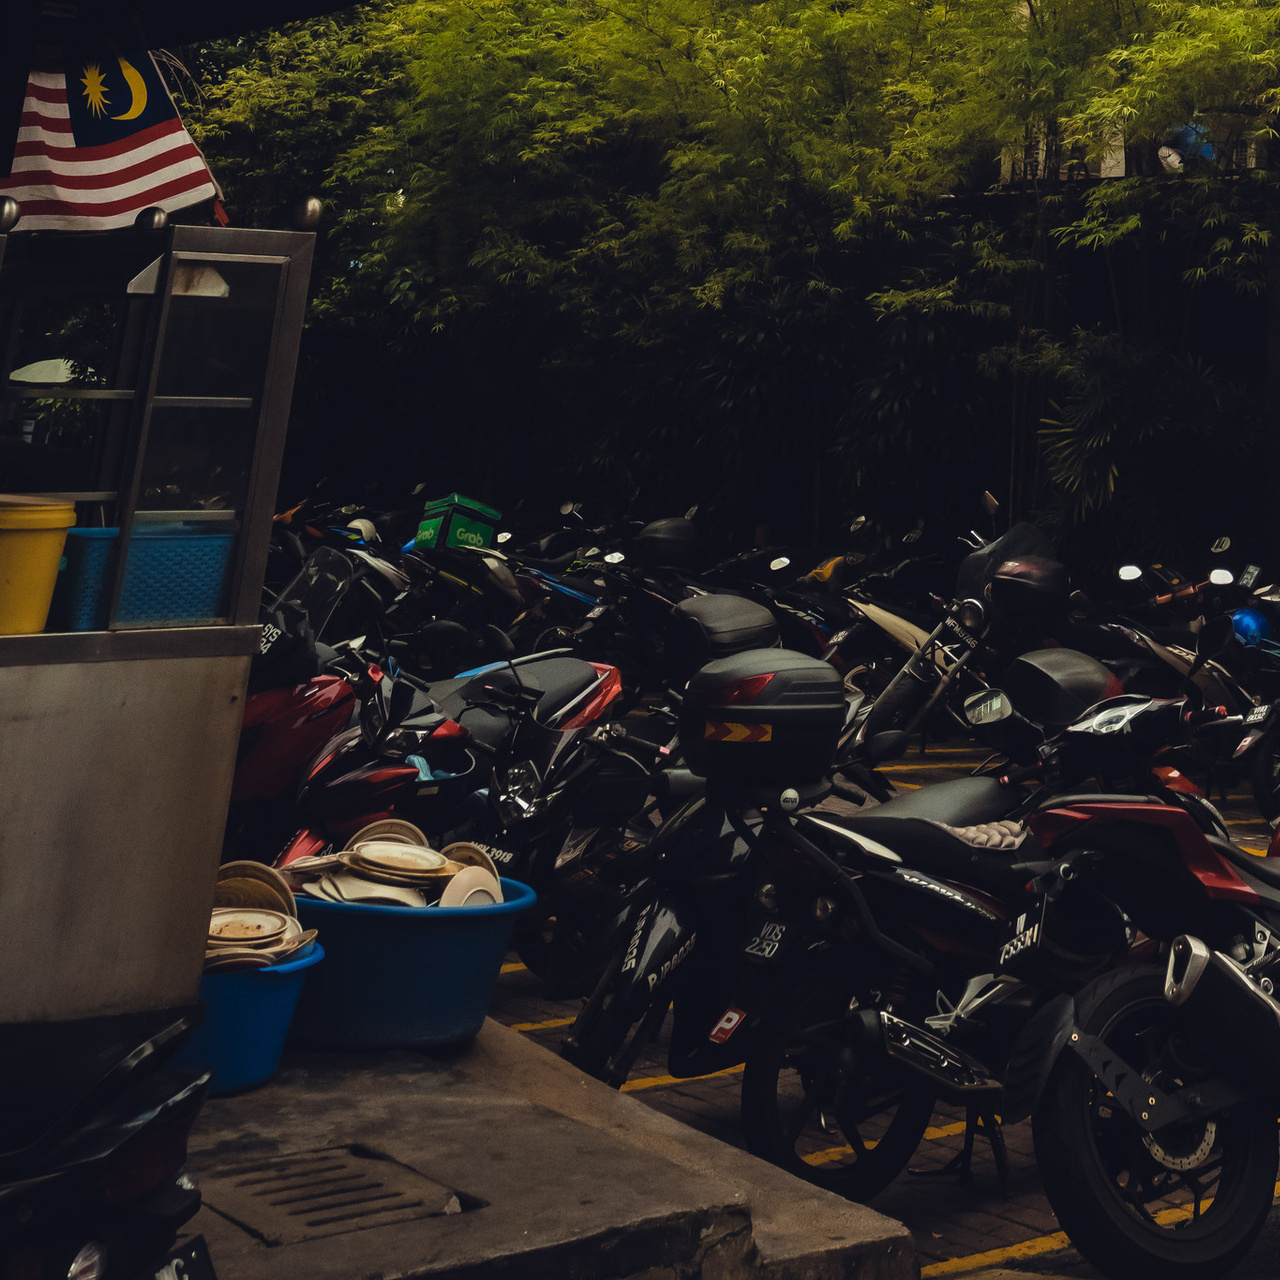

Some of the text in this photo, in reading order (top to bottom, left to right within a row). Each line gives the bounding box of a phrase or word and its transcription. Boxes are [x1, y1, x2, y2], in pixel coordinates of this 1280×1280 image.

[456, 527, 484, 547] Grab
[944, 615, 978, 649] WFM9746
[759, 921, 786, 941] VDS
[744, 937, 779, 958] 2250
[711, 1011, 740, 1035] P
